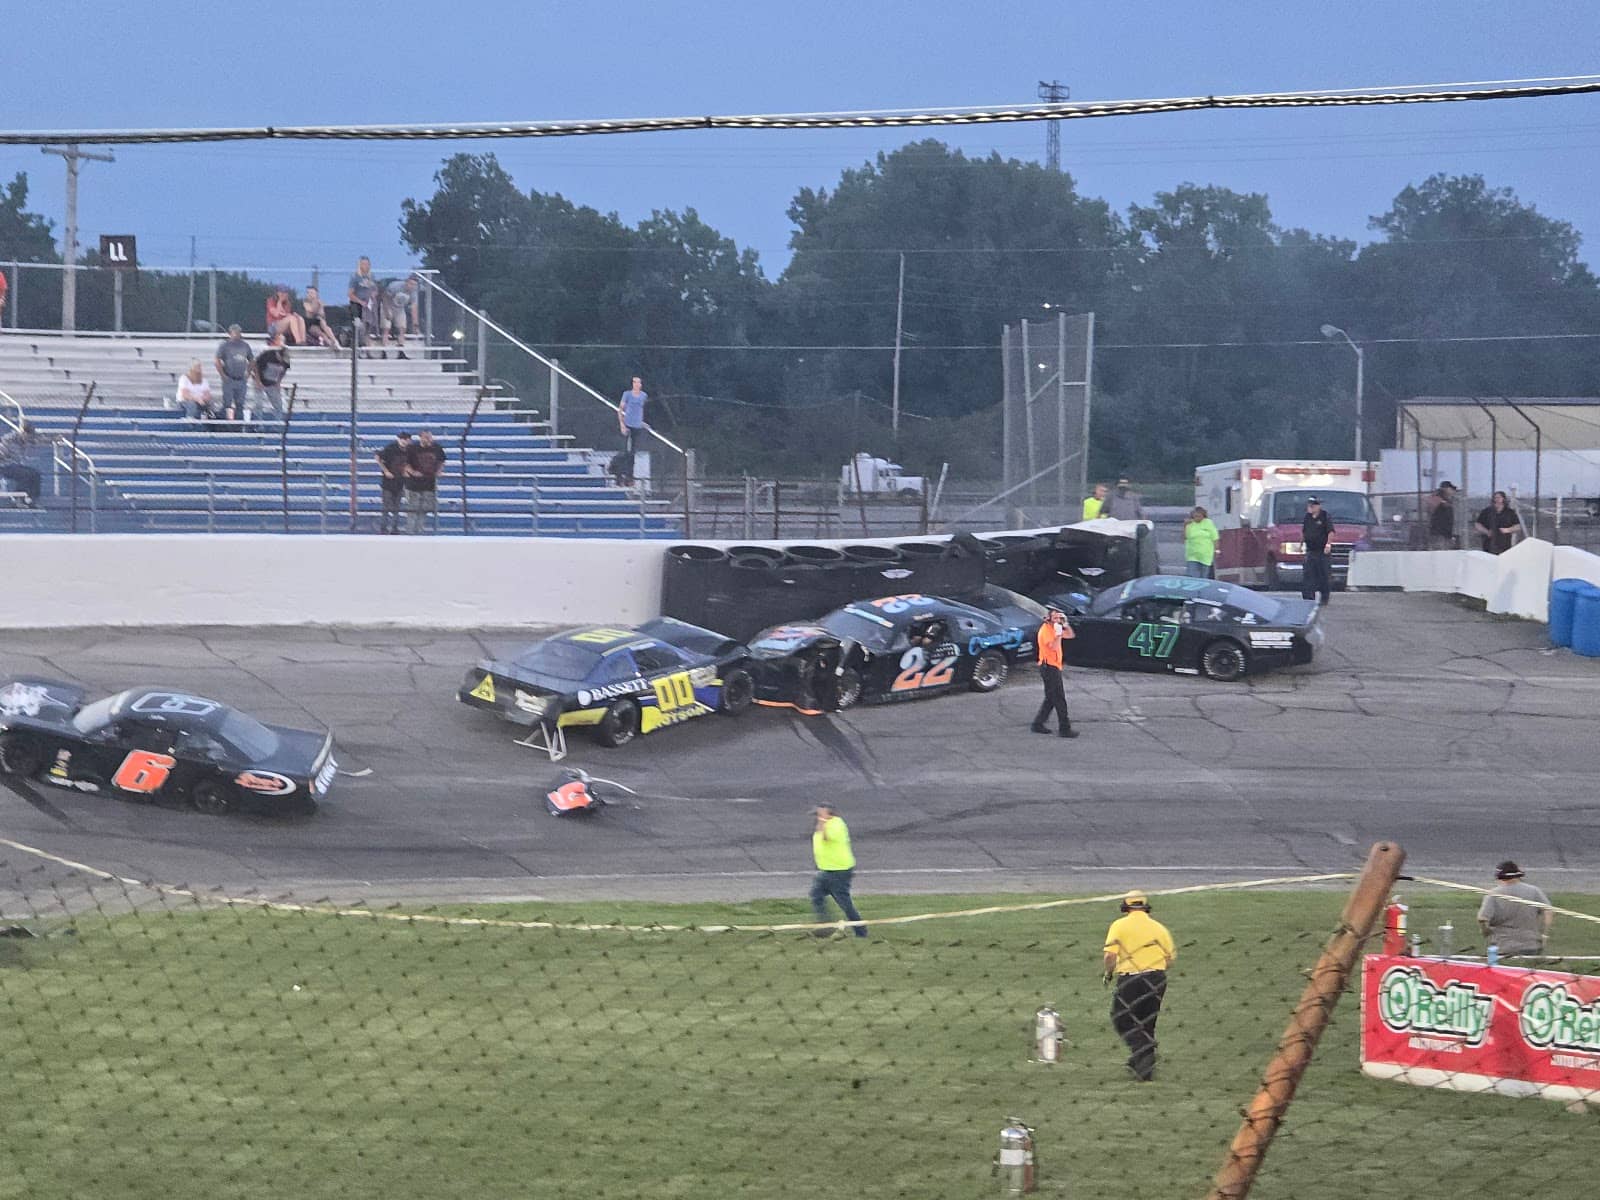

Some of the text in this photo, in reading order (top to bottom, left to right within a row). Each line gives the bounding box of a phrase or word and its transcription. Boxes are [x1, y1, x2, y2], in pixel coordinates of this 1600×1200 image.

[1127, 622, 1181, 658] 47
[890, 642, 961, 692] 22
[590, 678, 649, 701] BASSETT
[651, 671, 696, 712] 00
[111, 748, 178, 794] 6
[1383, 972, 1491, 1043] O'Reilly
